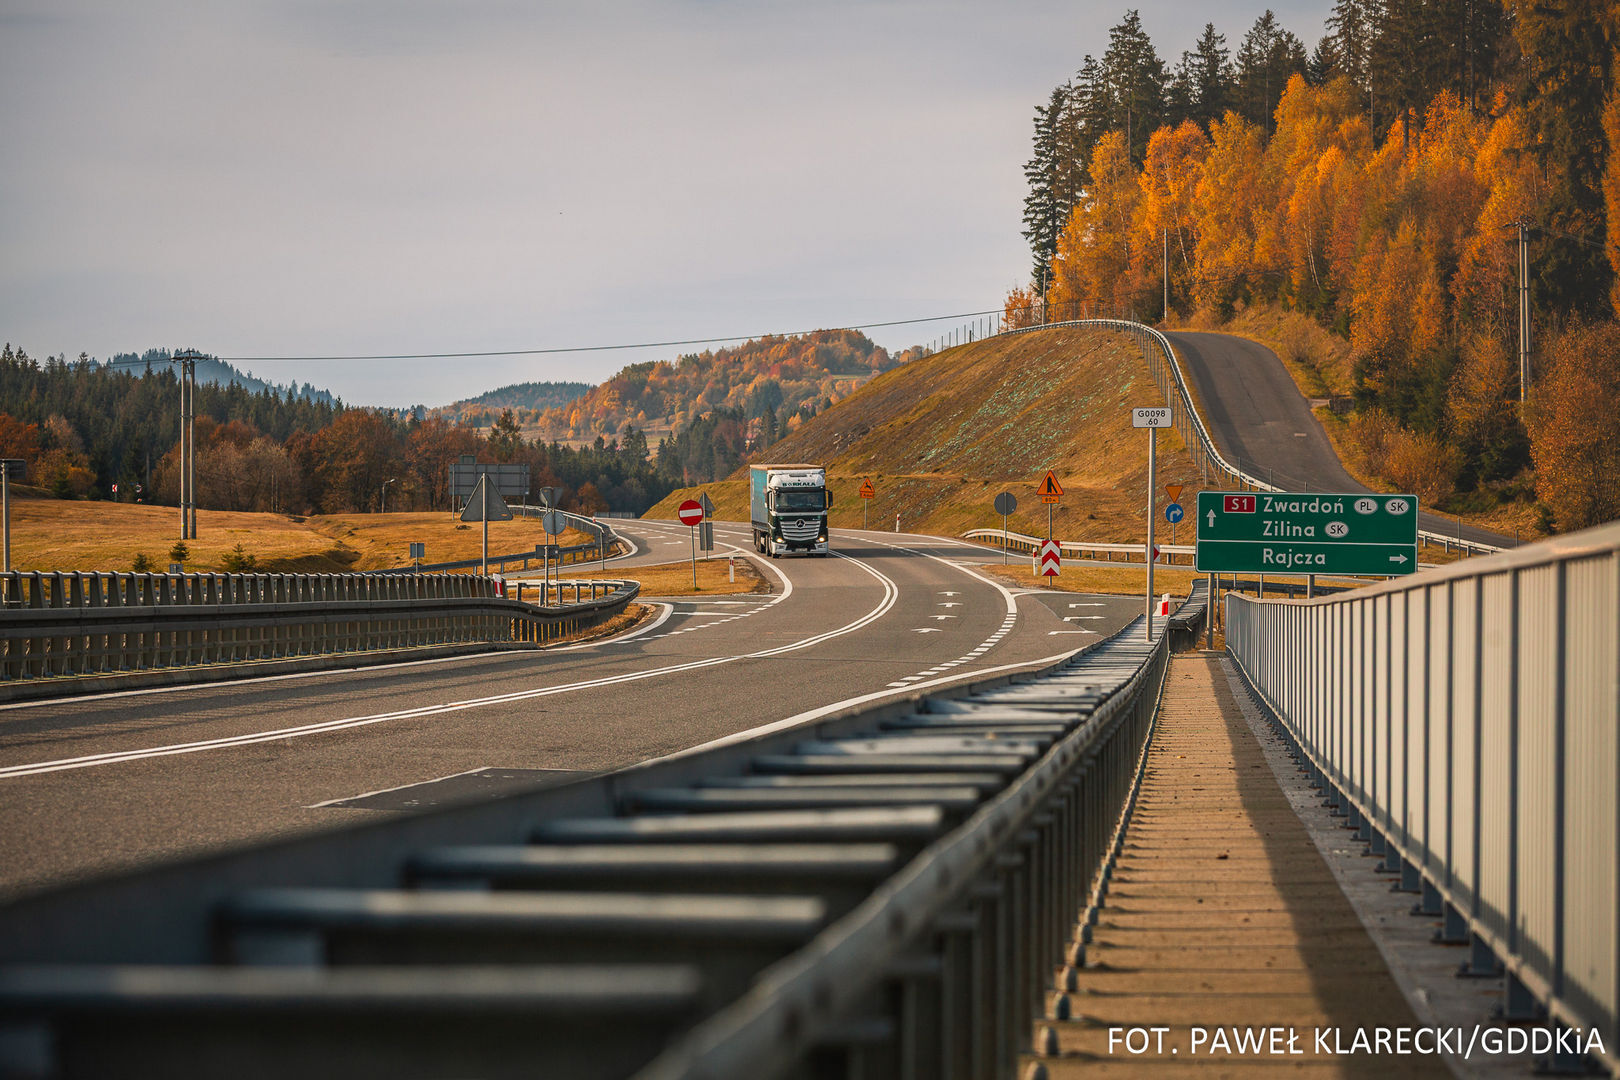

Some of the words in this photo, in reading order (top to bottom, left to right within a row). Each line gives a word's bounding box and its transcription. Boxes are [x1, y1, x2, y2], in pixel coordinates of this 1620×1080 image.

[1138, 410, 1166, 418] G0098
[1231, 498, 1248, 511] S1
[1263, 496, 1344, 514] Zwardoń
[1360, 501, 1372, 512] PL
[1390, 501, 1404, 512] SK
[1263, 520, 1315, 537] Zilina
[1330, 524, 1344, 535] SK
[1263, 548, 1327, 568] Rajcza
